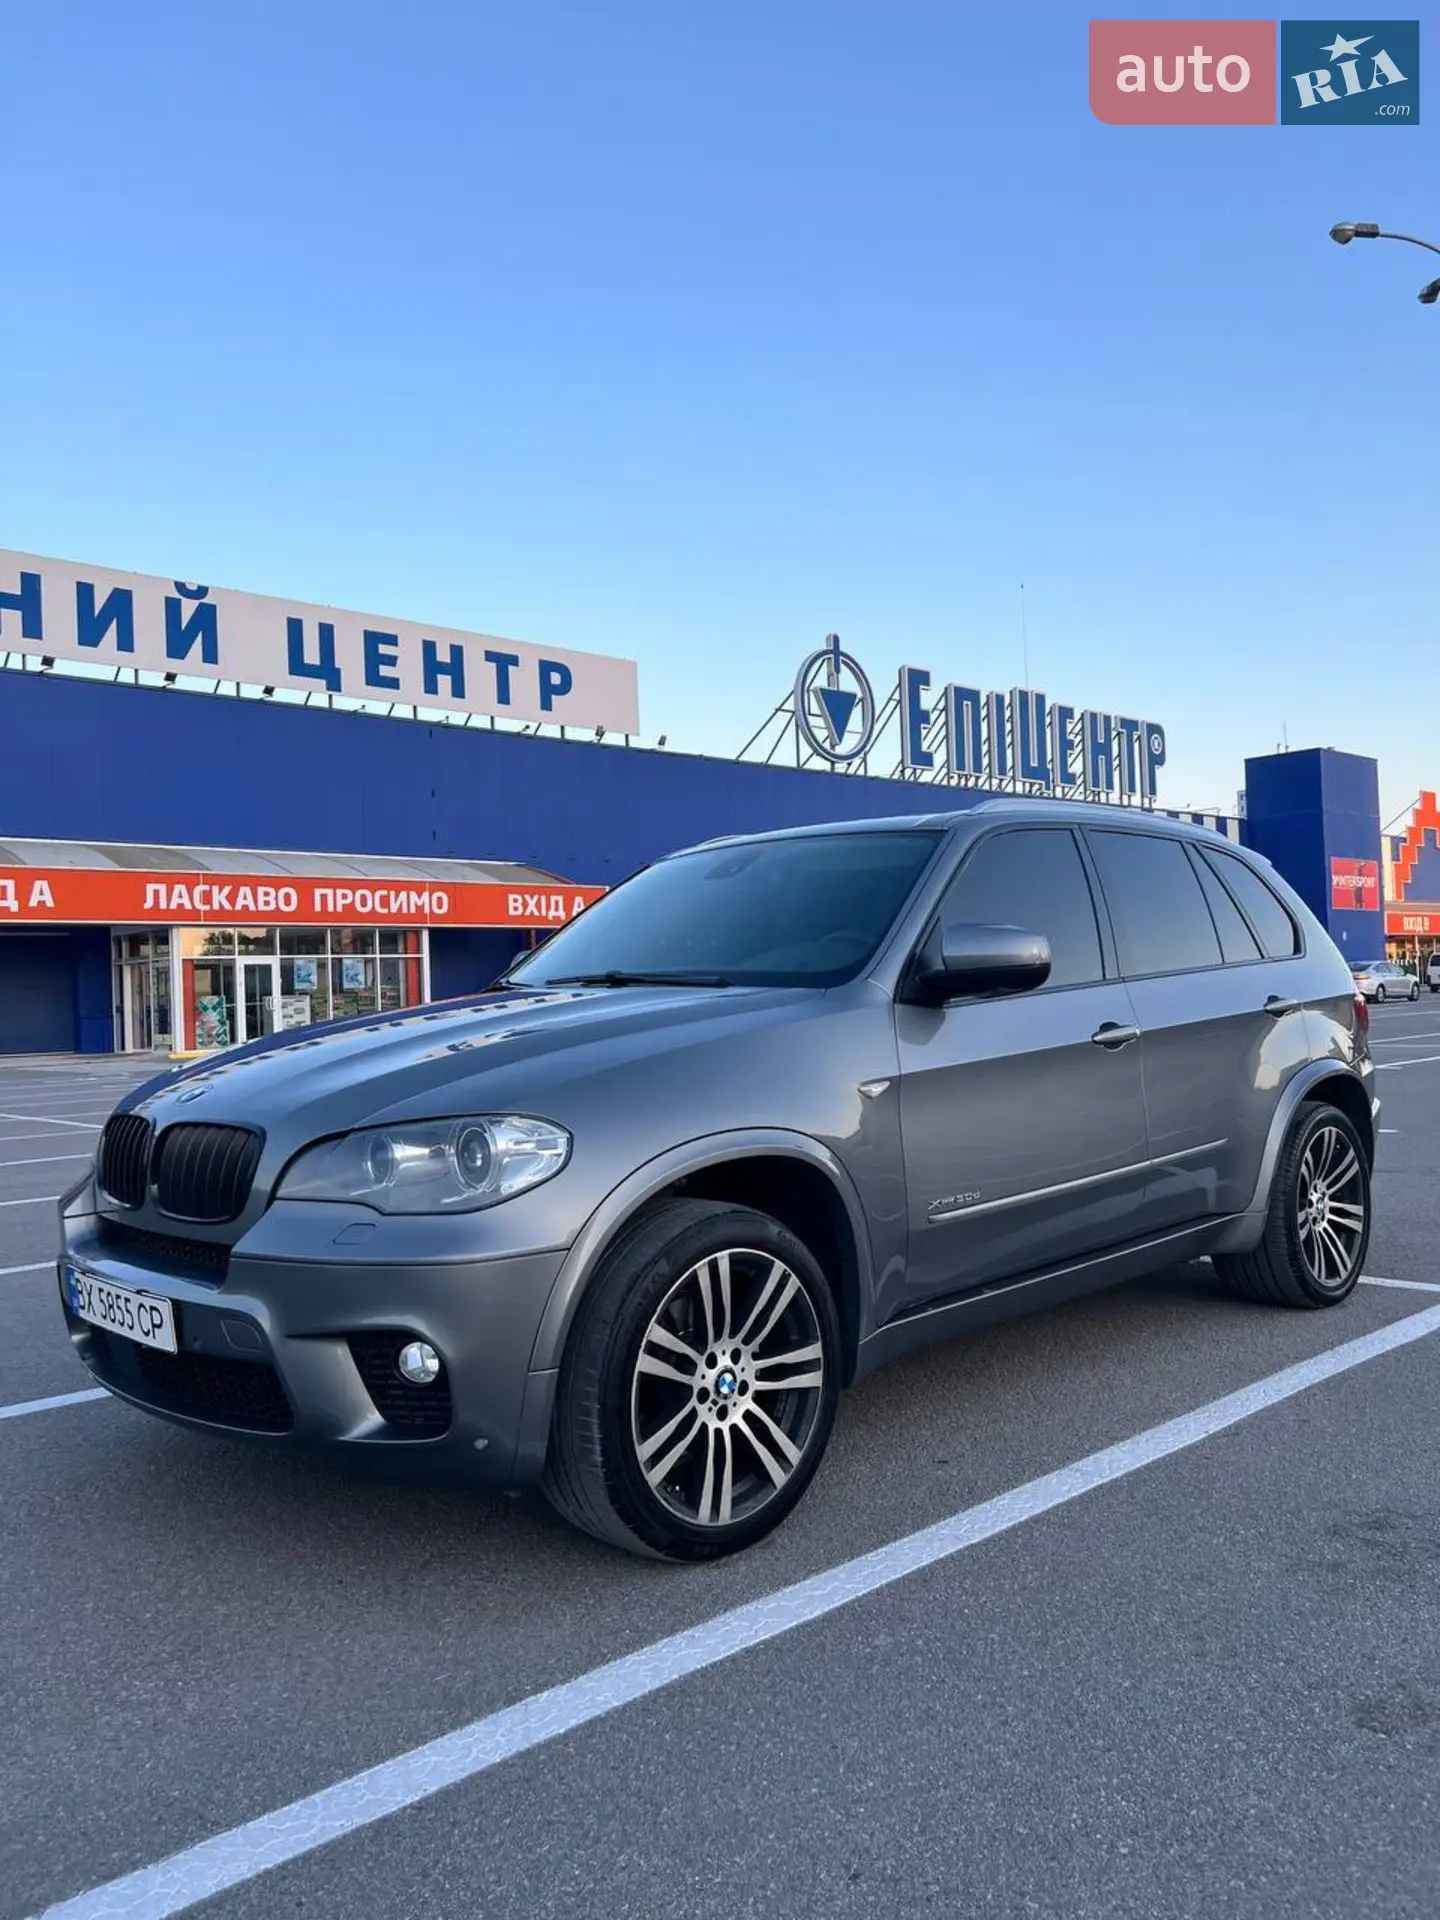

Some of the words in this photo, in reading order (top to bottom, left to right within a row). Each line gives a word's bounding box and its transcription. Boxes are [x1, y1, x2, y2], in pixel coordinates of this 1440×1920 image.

[286, 616, 574, 712] ЦЕНТР
[28, 879, 55, 908] А
[143, 883, 298, 912] ЛАСКАВО
[313, 887, 449, 915] ПРОСИМО
[507, 893, 566, 920] ВХІД
[98, 1287, 135, 1331] 5855
[138, 1302, 164, 1340] CP
